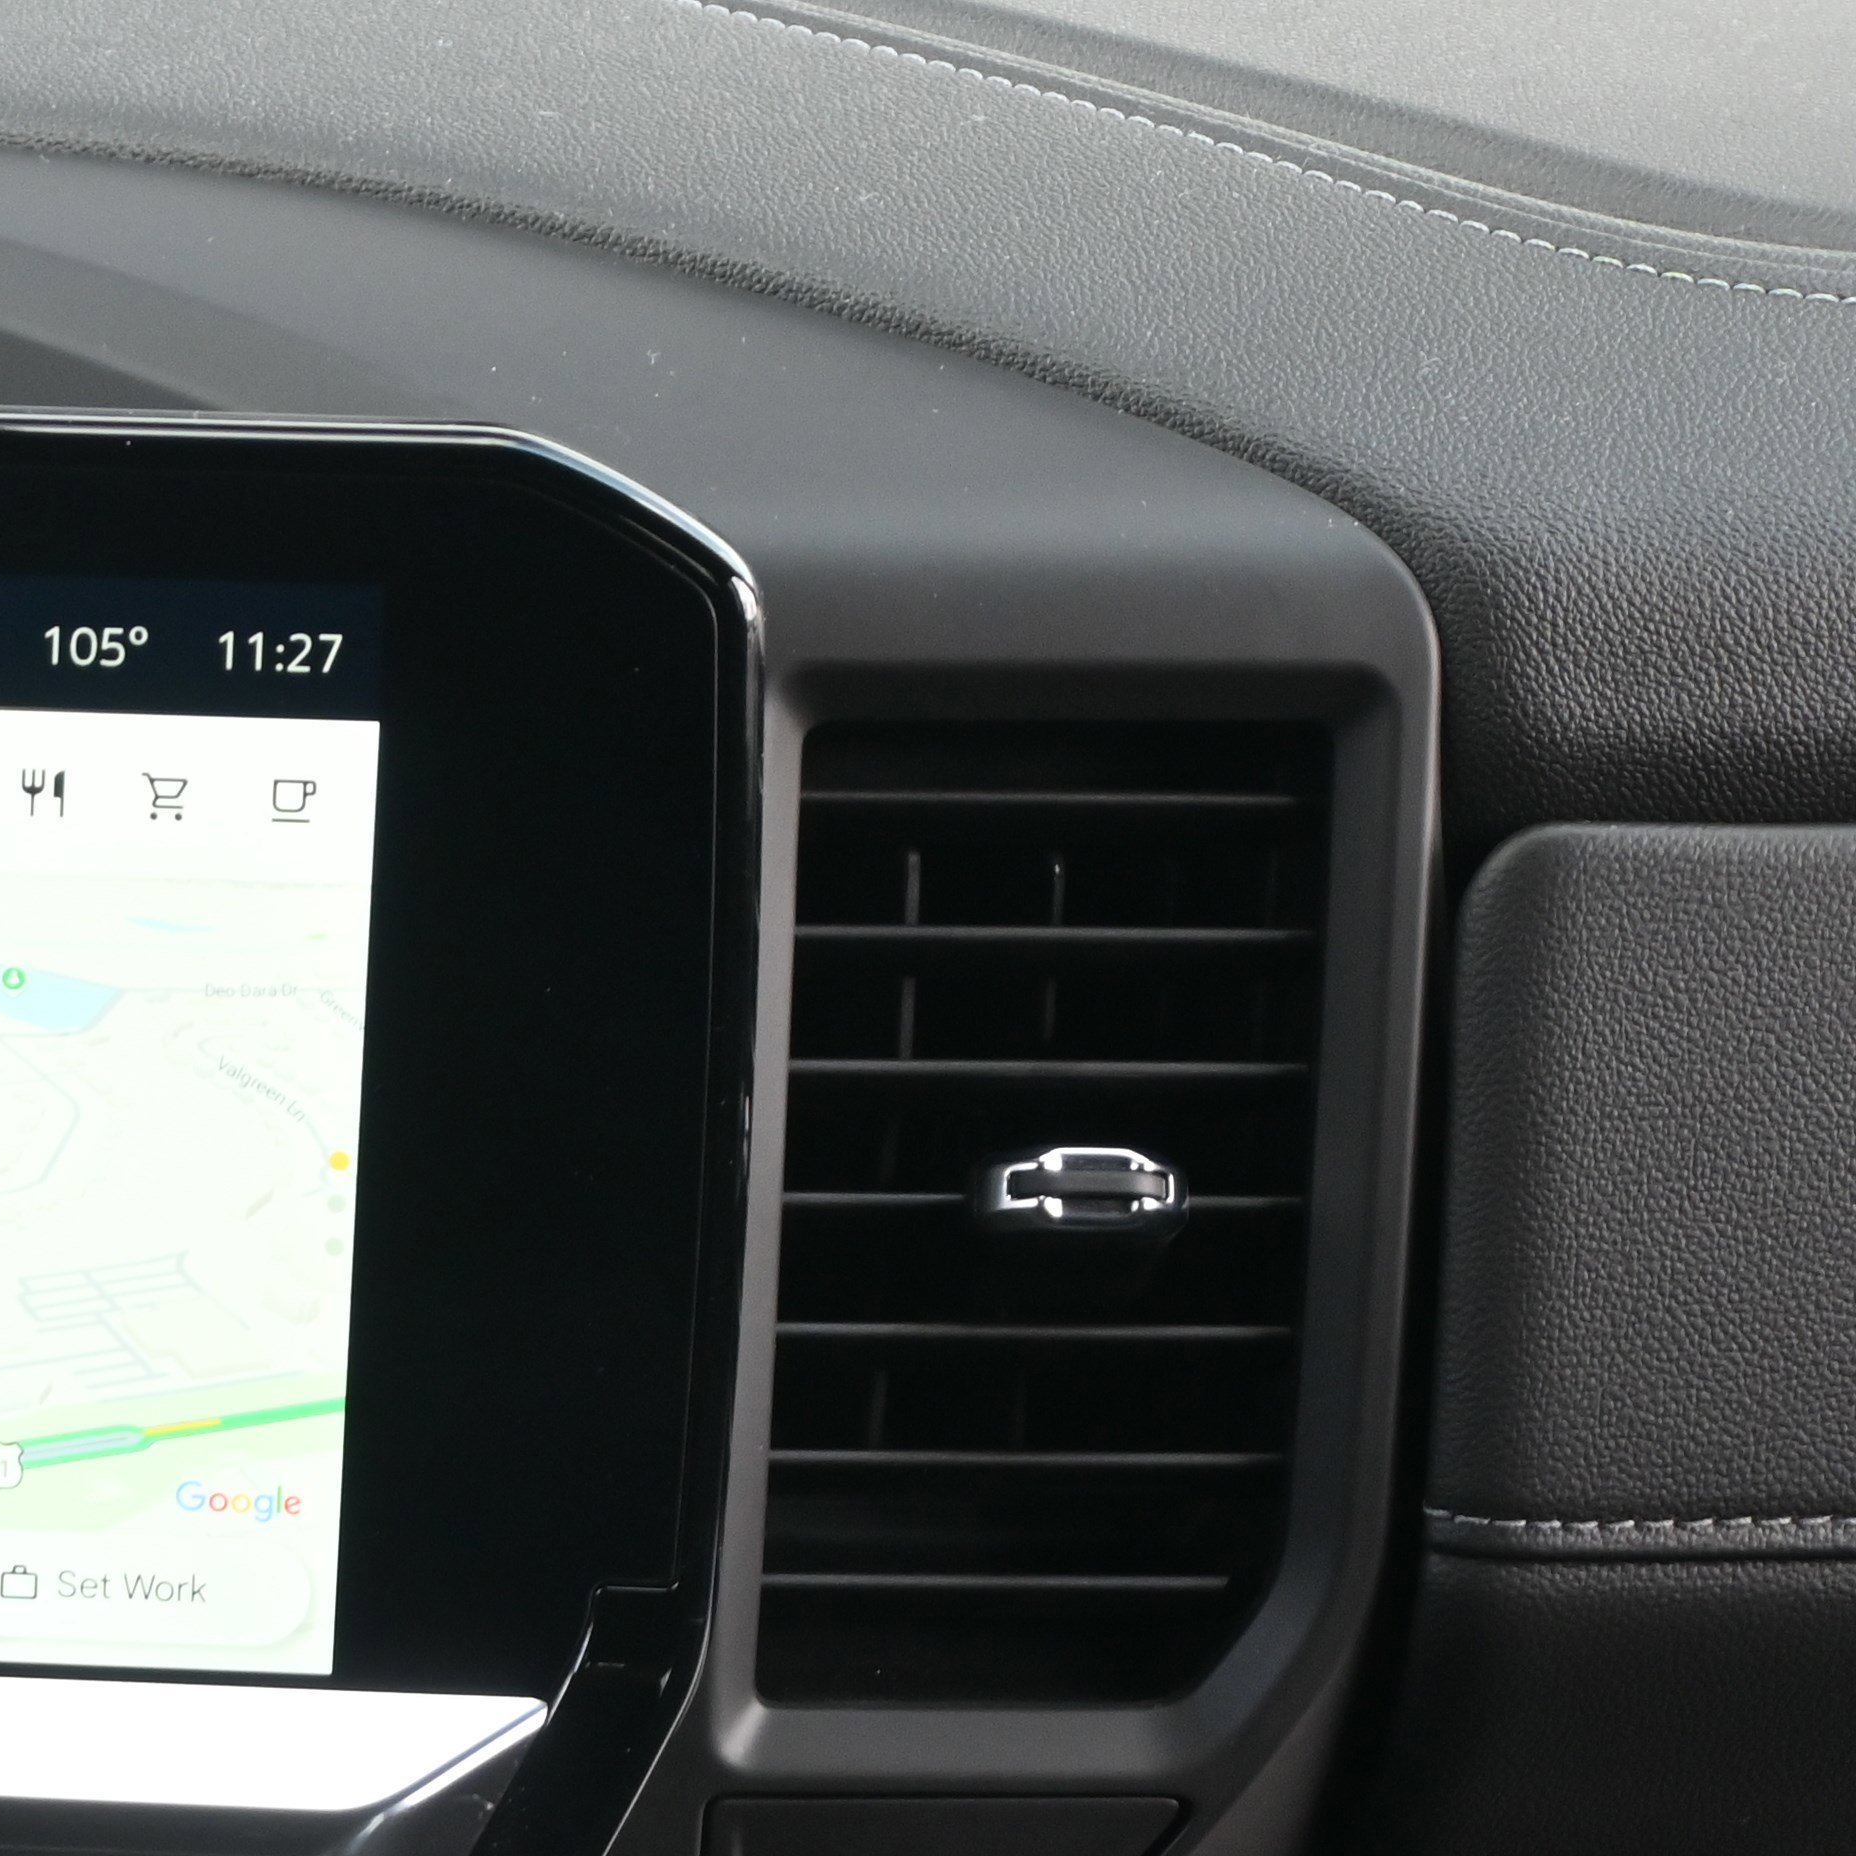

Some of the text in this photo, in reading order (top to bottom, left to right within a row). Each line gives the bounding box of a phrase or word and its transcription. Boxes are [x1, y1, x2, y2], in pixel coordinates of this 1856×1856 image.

[44, 625, 149, 668] 105°
[218, 630, 343, 674] 11:27
[216, 1055, 306, 1122] Valgreen Ln
[175, 1479, 302, 1523] Google
[57, 1570, 205, 1602] Set Work
